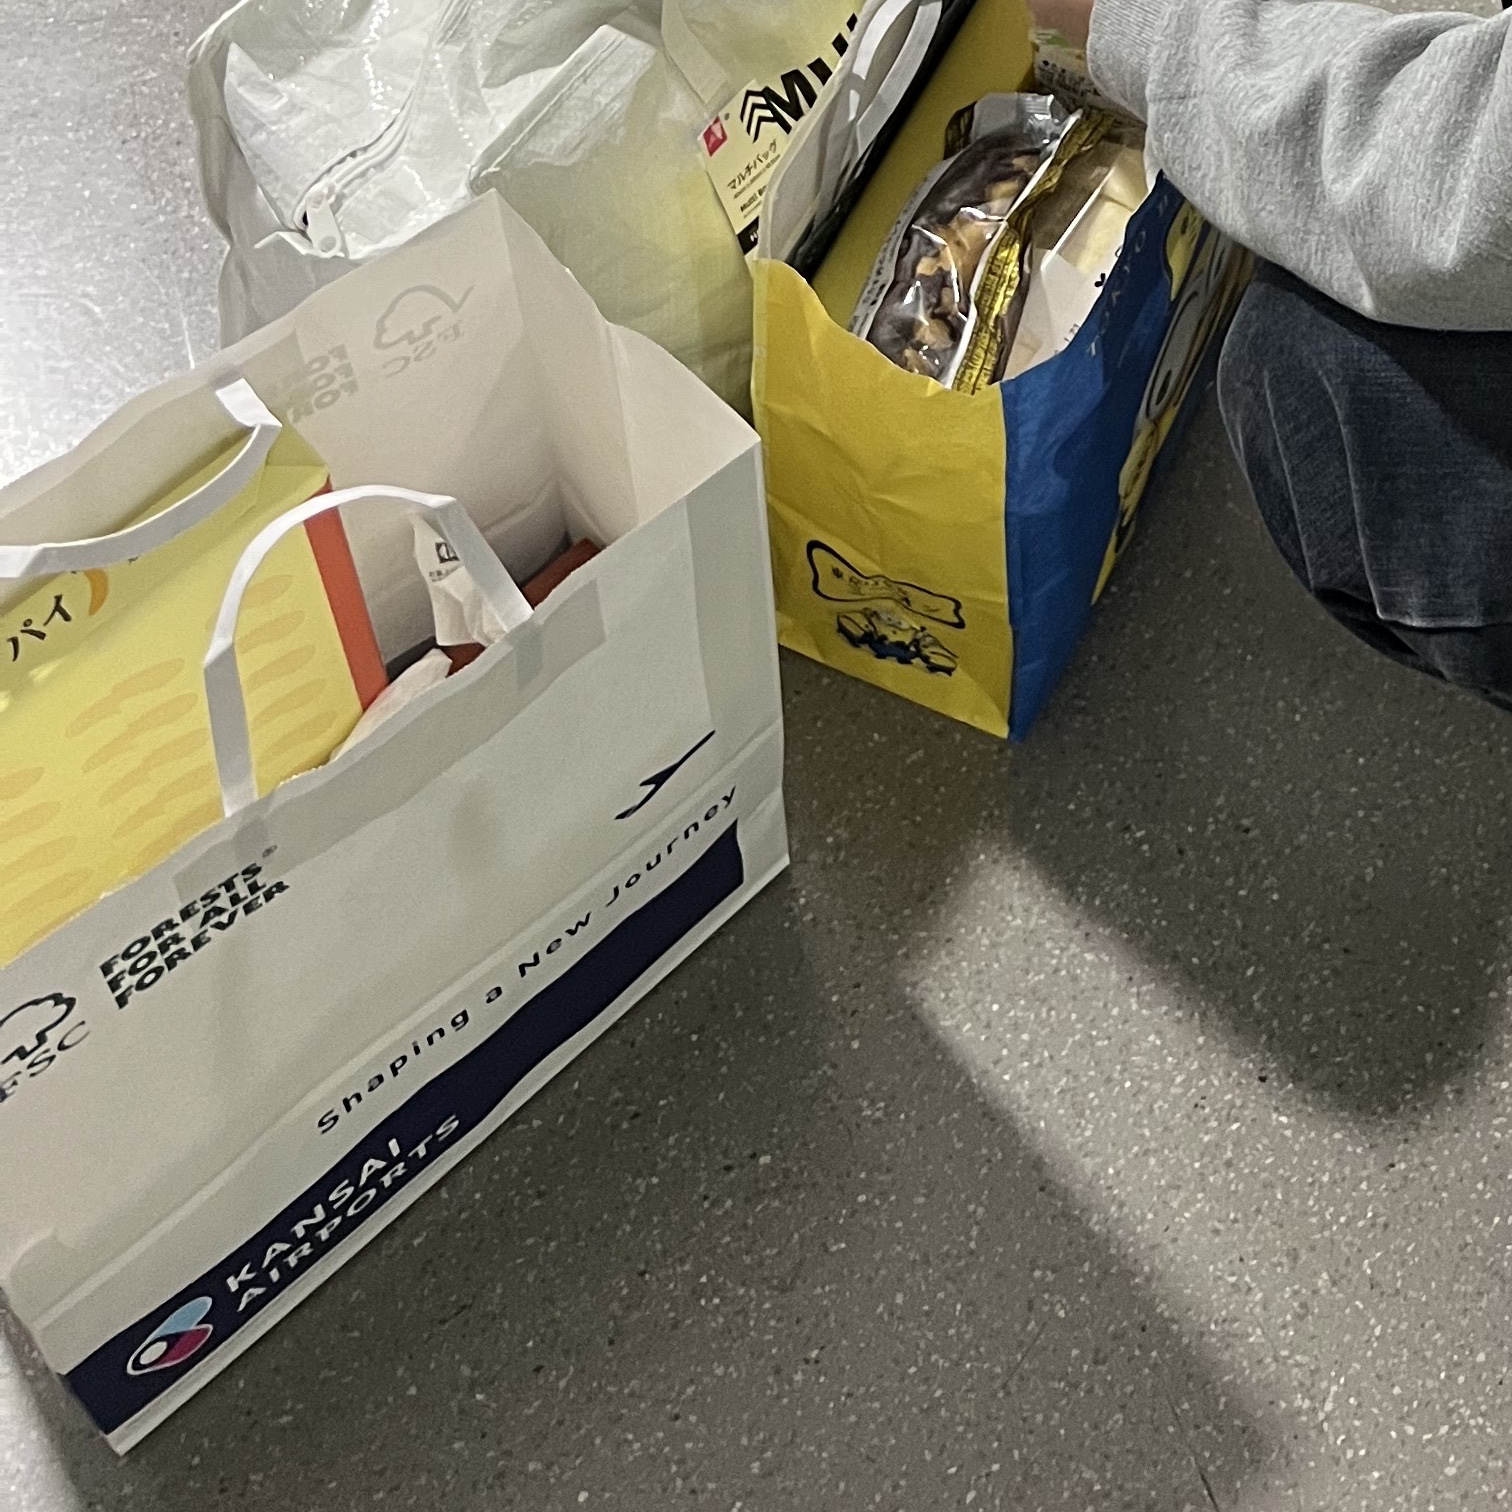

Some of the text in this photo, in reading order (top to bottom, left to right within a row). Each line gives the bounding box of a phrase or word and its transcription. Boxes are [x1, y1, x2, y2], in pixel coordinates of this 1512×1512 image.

[7, 594, 72, 662] パイ
[107, 879, 267, 994] FOR ALL
[115, 881, 289, 1010] FOREVER
[317, 785, 736, 1135] Shaping a New Journey
[226, 1138, 400, 1292] KANSAI
[238, 1114, 460, 1312] AIRPORTS
